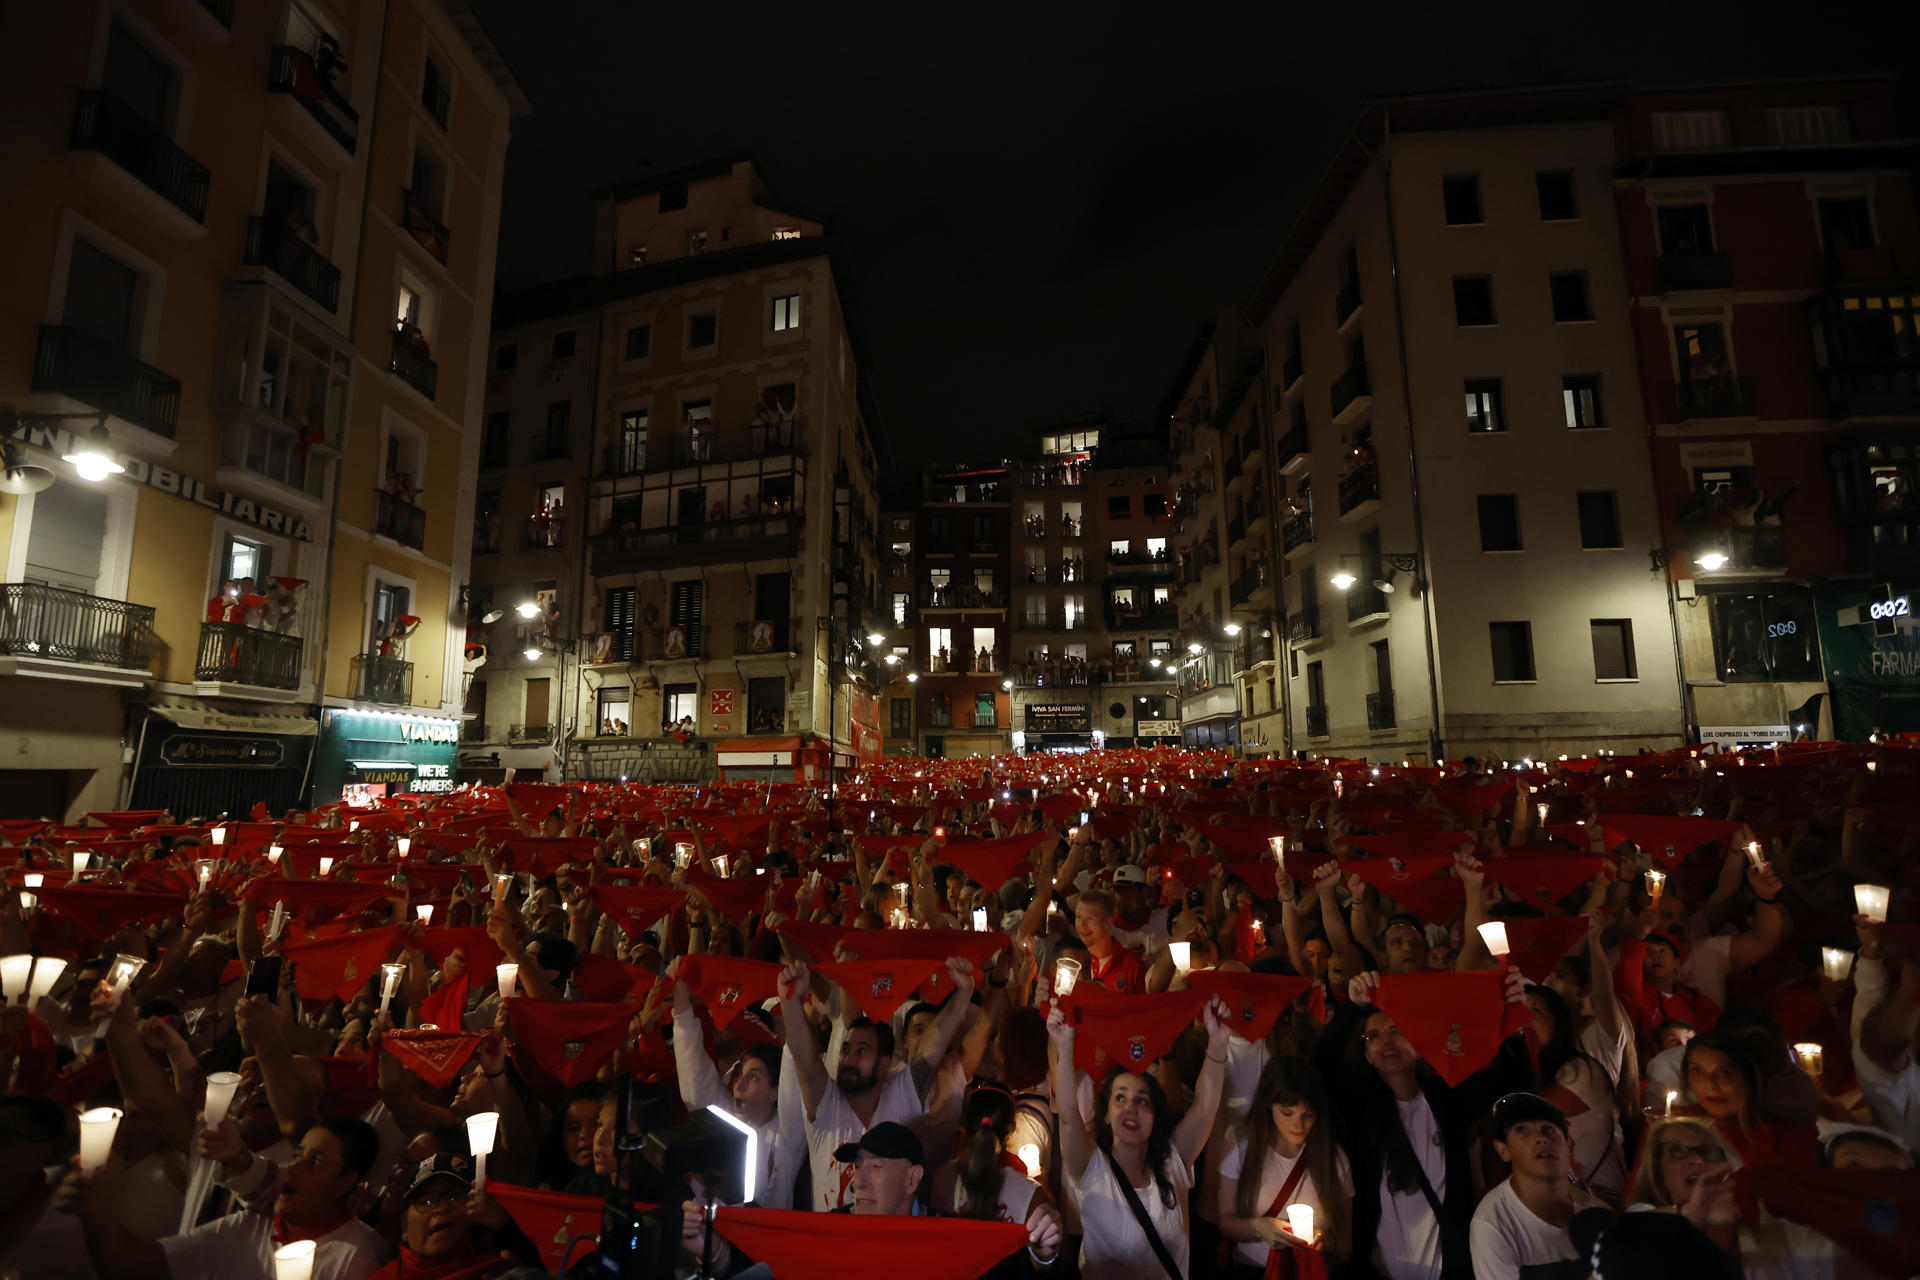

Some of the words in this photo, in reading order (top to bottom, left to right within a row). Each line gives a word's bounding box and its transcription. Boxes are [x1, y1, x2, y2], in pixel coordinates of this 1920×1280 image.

[11, 419, 315, 543] INOBILIARIA
[1870, 597, 1908, 620] 0:02
[1048, 704, 1061, 712] SAN
[400, 722, 458, 743] VIANDAS
[364, 771, 409, 783] VIANDAS
[418, 764, 449, 777] WE'RE
